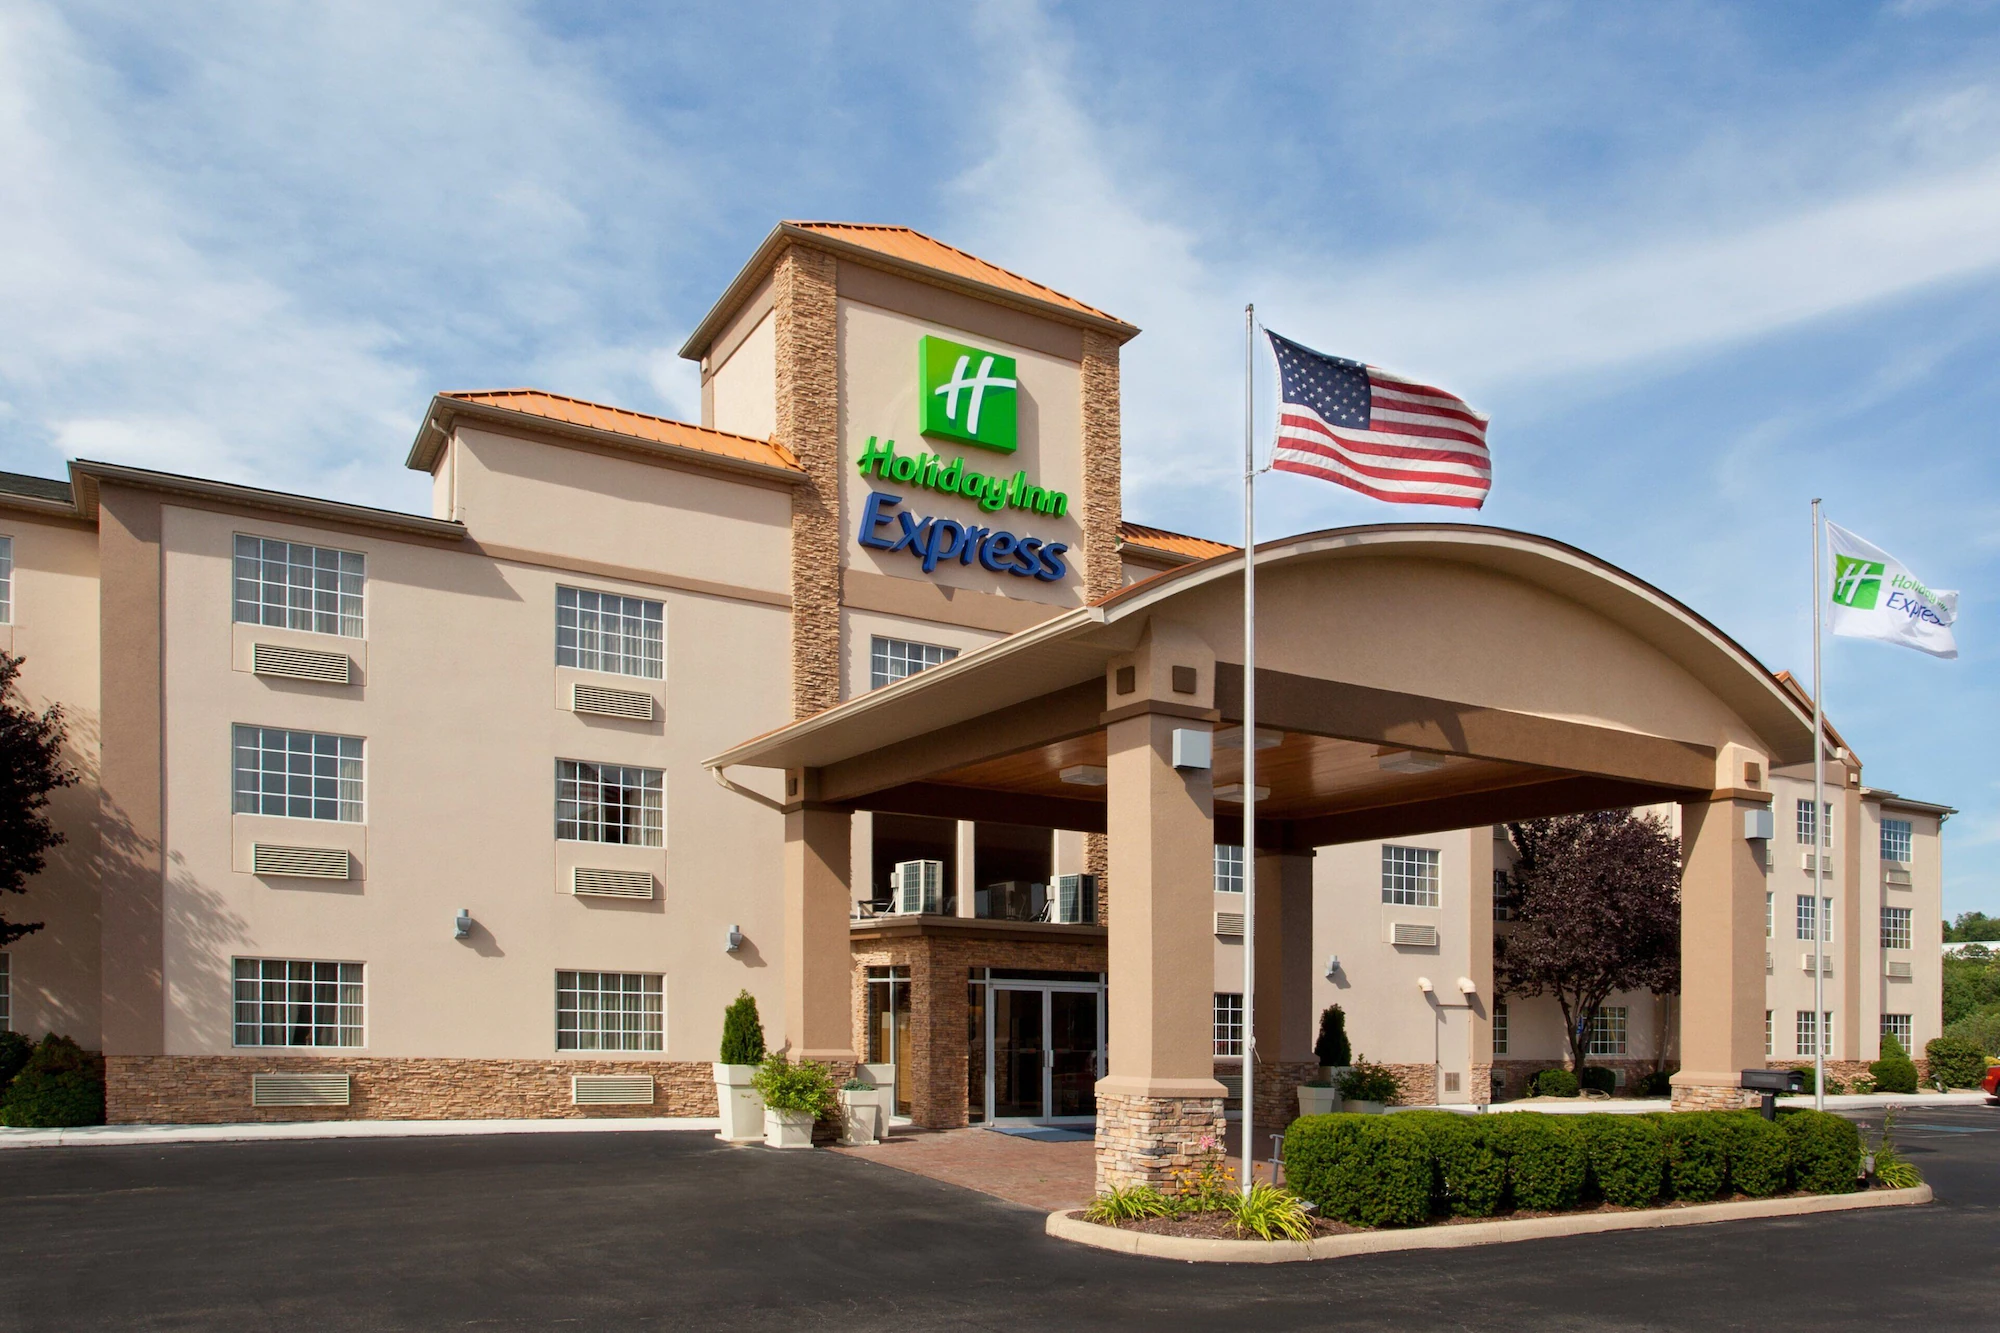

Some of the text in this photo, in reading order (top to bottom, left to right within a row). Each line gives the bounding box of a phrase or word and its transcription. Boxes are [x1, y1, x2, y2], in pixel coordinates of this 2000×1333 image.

[857, 436, 1069, 519] Holiday Inn
[858, 491, 1068, 582] Express
[1886, 592, 1946, 627] Expres
[1891, 574, 1937, 604] Holiday
